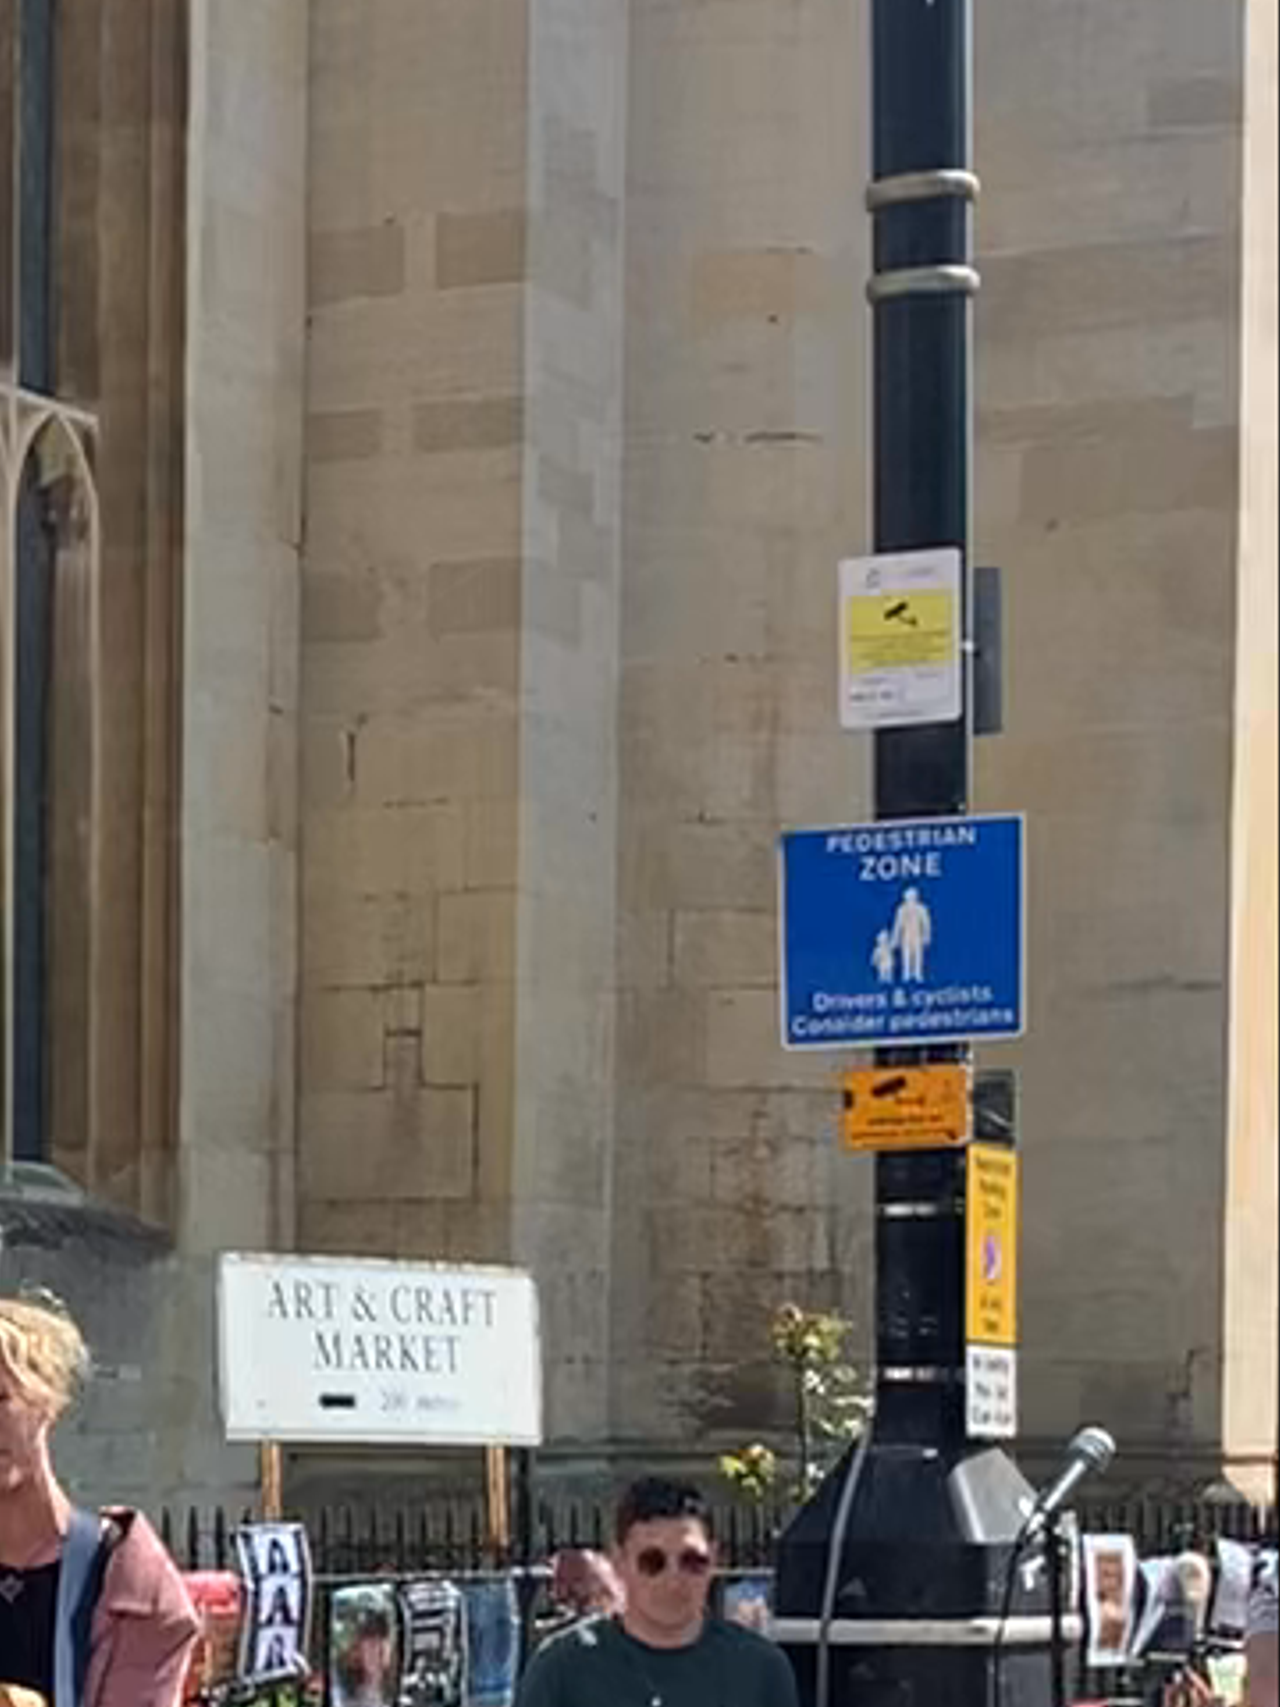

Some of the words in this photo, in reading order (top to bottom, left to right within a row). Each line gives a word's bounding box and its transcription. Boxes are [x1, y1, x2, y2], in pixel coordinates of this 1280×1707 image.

[826, 826, 977, 853] PEDESTRIAN
[859, 853, 942, 881] ZONE
[812, 991, 887, 1013] Drivers
[892, 988, 907, 1008] &
[911, 985, 993, 1008] cyclists
[790, 1013, 885, 1037] Consider
[889, 1007, 1014, 1035] pedestrians
[268, 1280, 339, 1319] ART
[352, 1281, 378, 1323] &
[389, 1284, 498, 1328] CRAFT
[313, 1329, 461, 1374] MARKET
